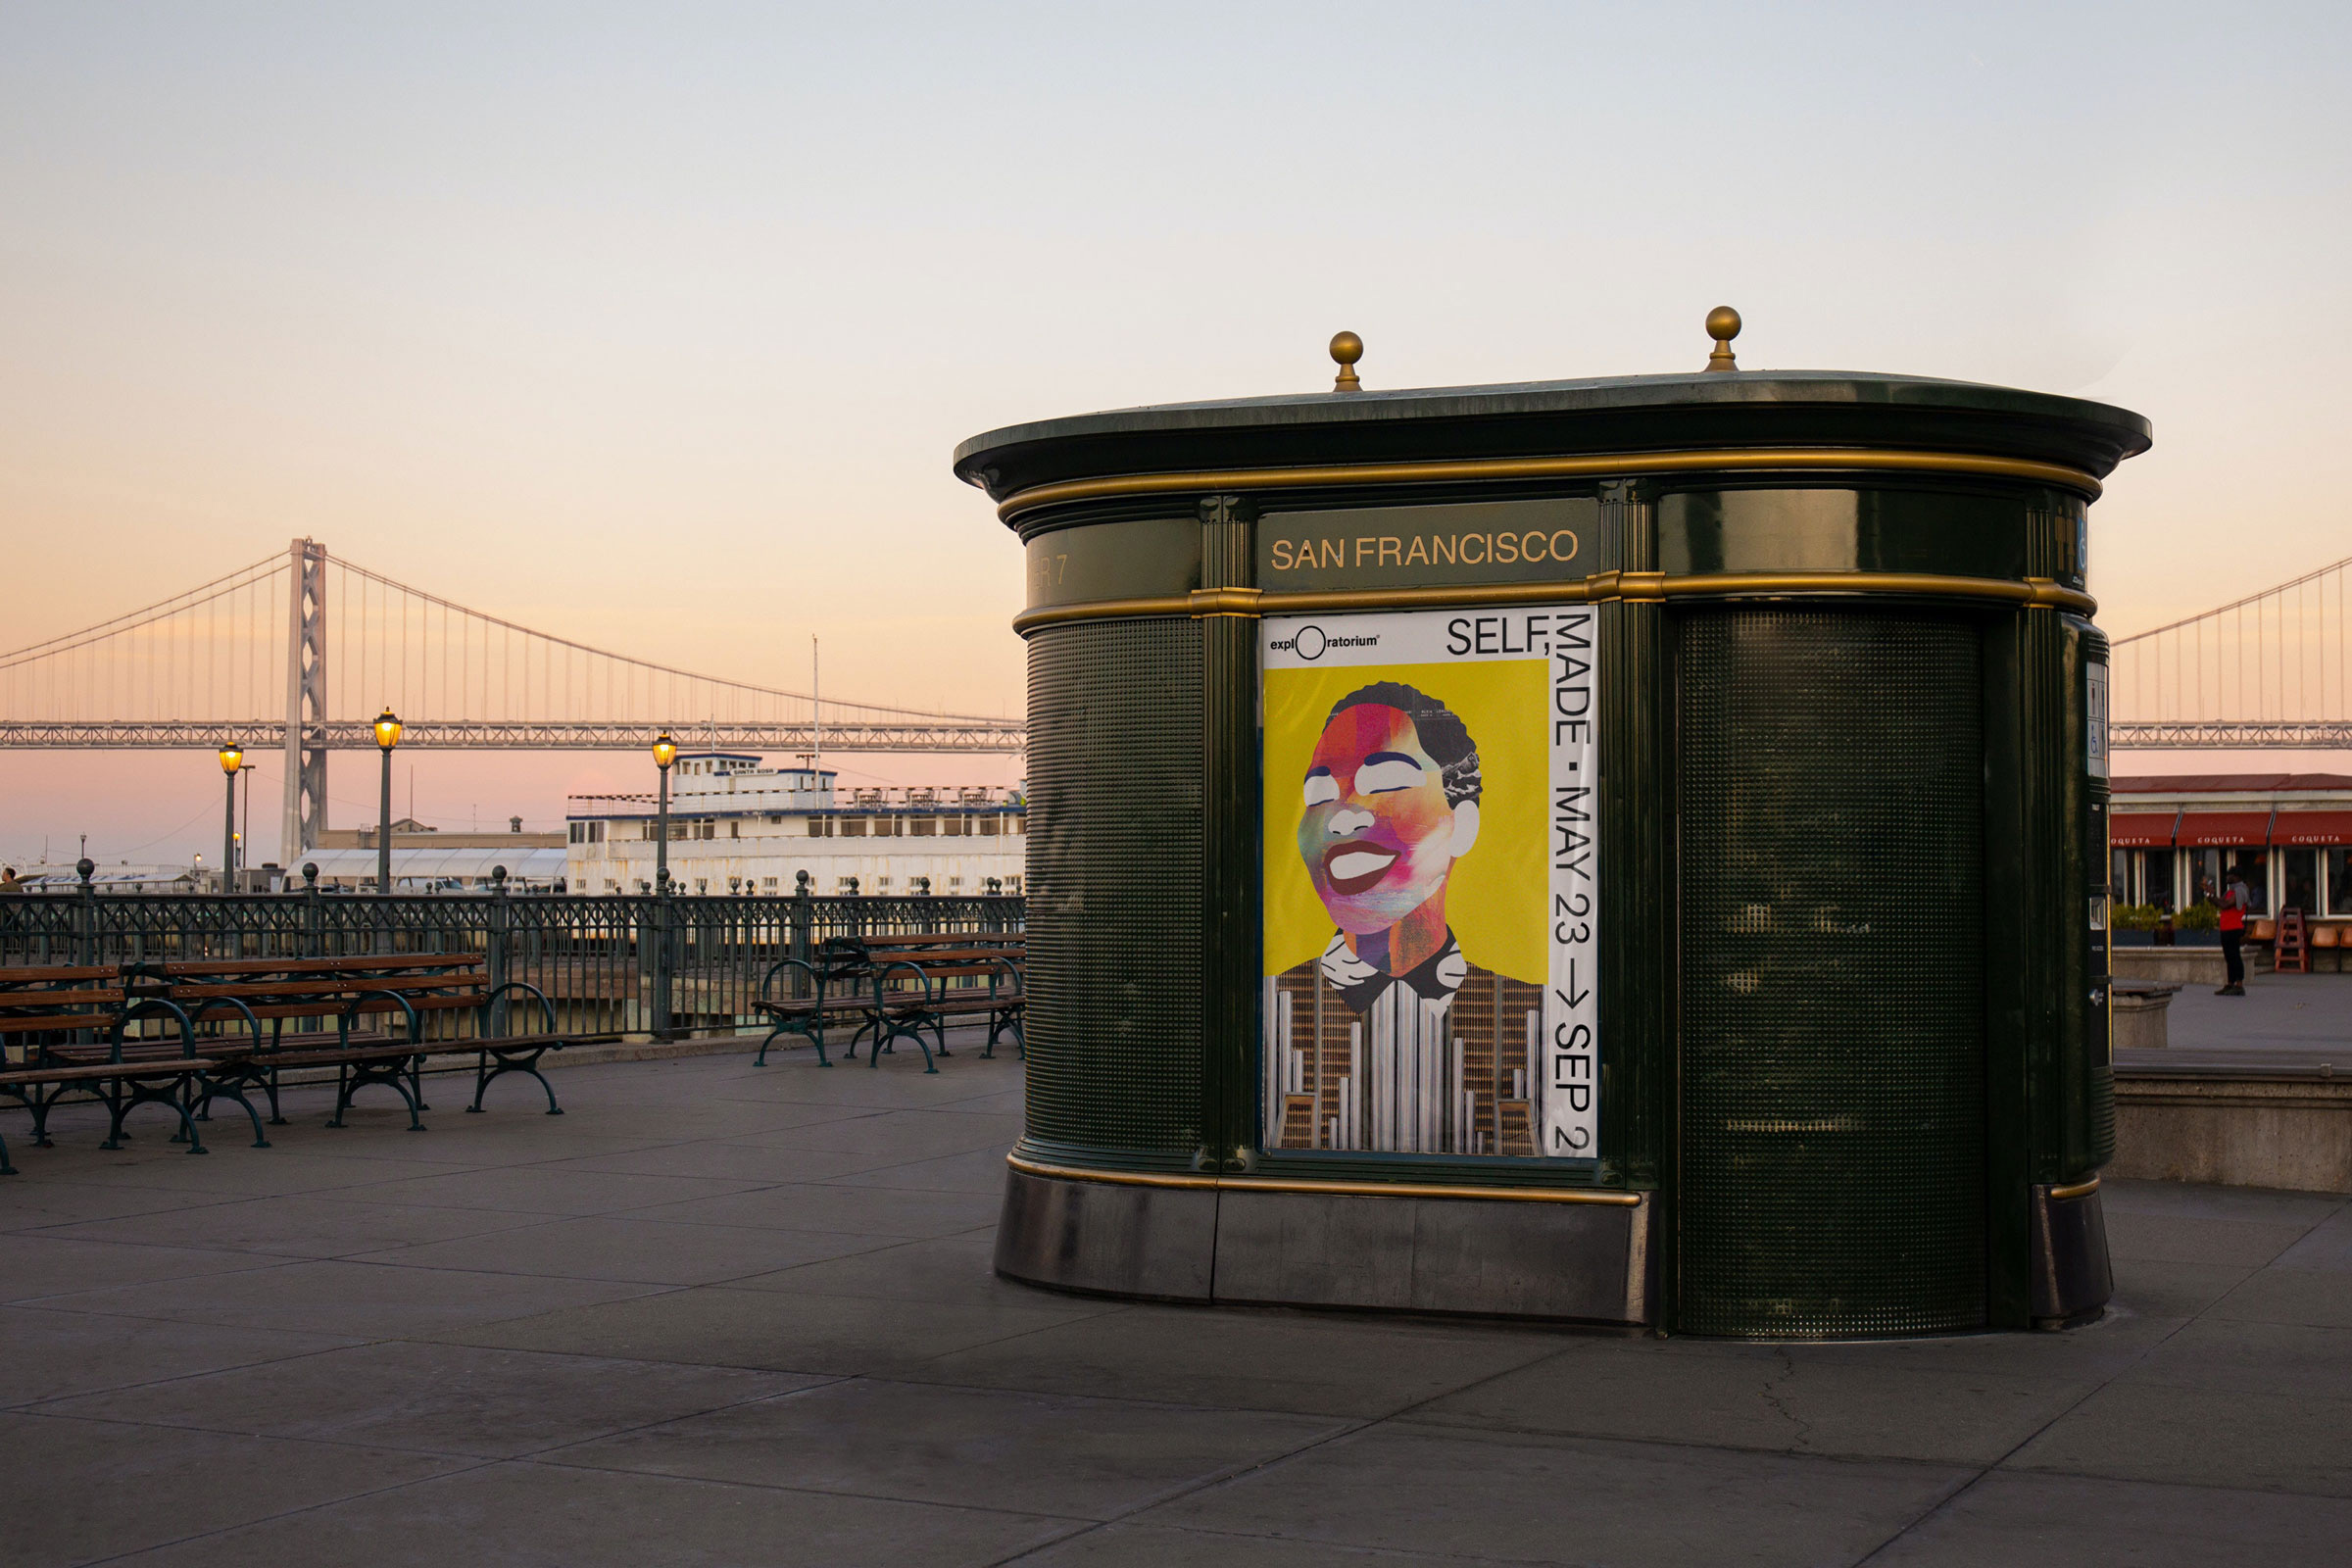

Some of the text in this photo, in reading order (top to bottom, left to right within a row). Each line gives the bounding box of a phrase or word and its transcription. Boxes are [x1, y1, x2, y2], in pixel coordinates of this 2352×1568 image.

[1056, 554, 1067, 585] 7
[1271, 529, 1579, 570] SAN FRANCISCO
[1446, 614, 1550, 657] SELF,
[2197, 836, 2245, 845] COQUETA
[1554, 613, 1592, 1150] MADE MAY 23 SEP 2
